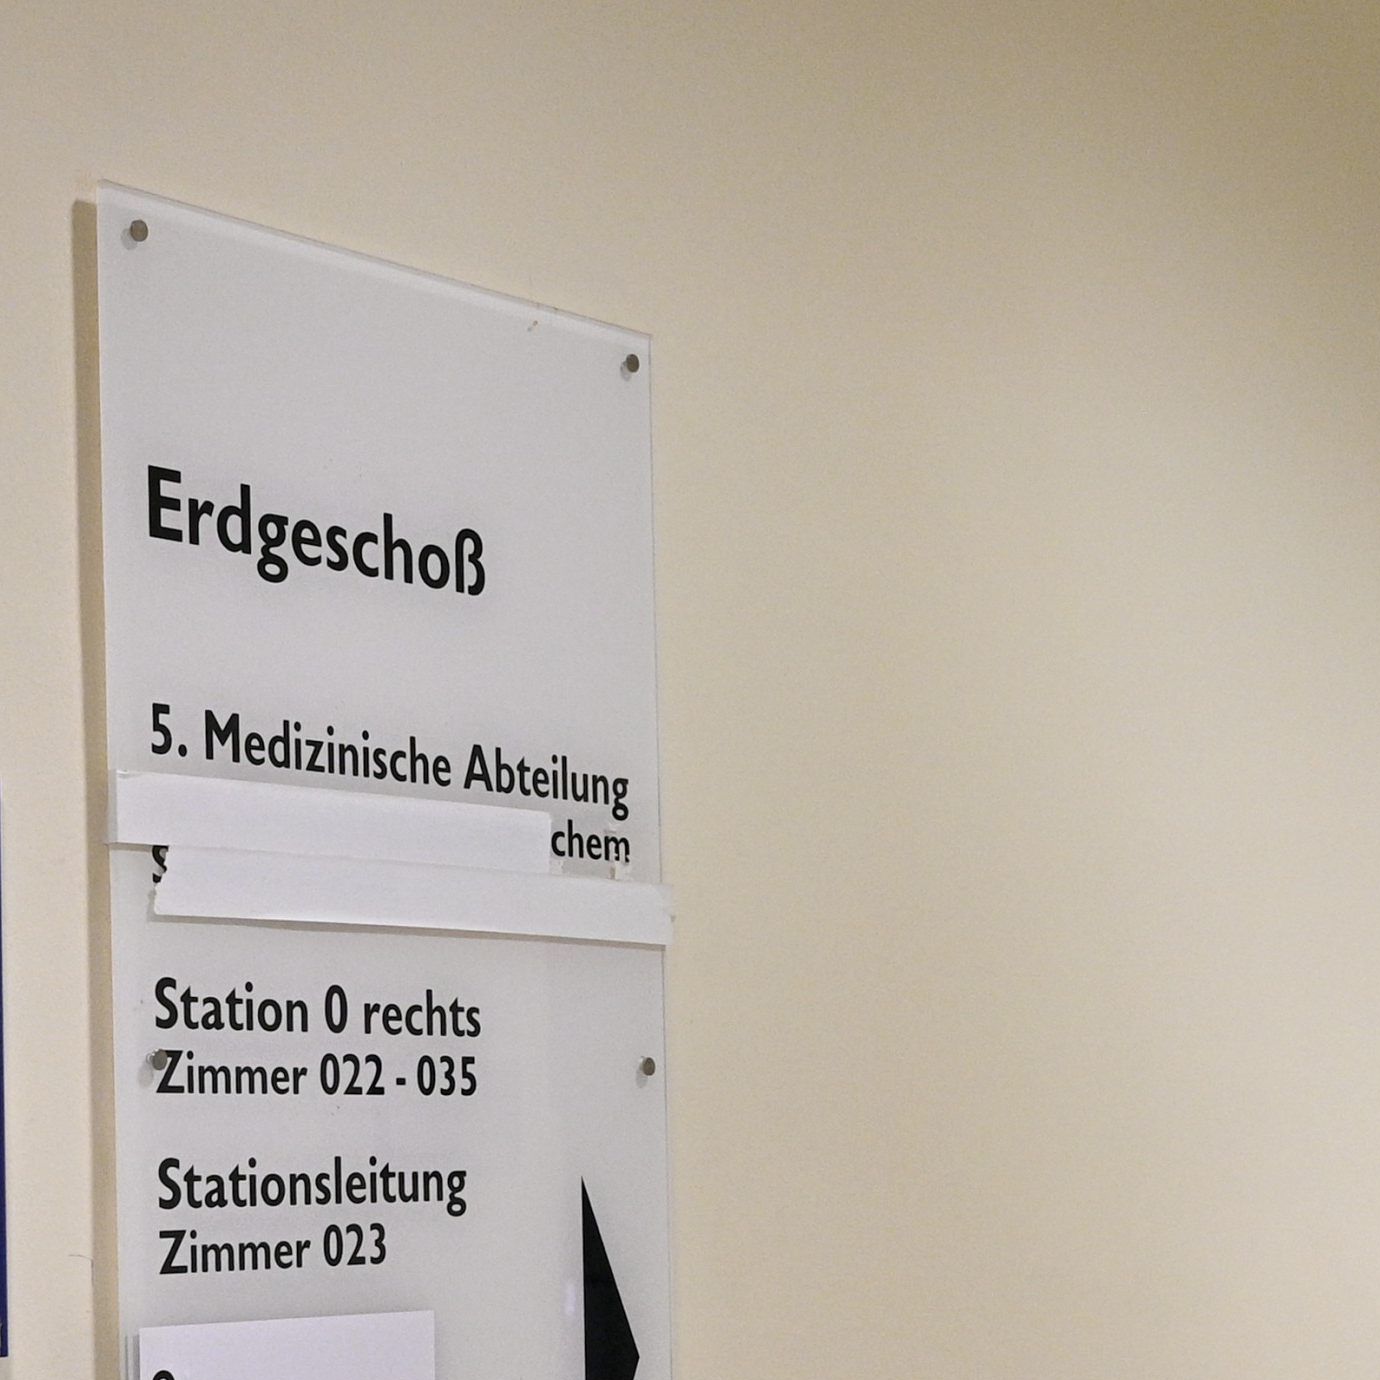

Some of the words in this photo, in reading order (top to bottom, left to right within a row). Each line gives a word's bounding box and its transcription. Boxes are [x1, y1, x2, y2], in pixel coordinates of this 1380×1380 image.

[147, 464, 486, 596] Erdgeschoß
[151, 702, 188, 758] 5.
[204, 709, 452, 787] Medizinische
[463, 743, 630, 822] Abteilung
[154, 976, 309, 1033] Station
[363, 988, 481, 1038] rechts
[153, 1049, 308, 1095] Zimmer
[320, 1052, 385, 1096] 022
[416, 1055, 477, 1097] 035
[158, 1155, 467, 1217] Stationsleitung
[159, 1229, 311, 1275] Zimmer
[323, 1222, 387, 1267] 023
